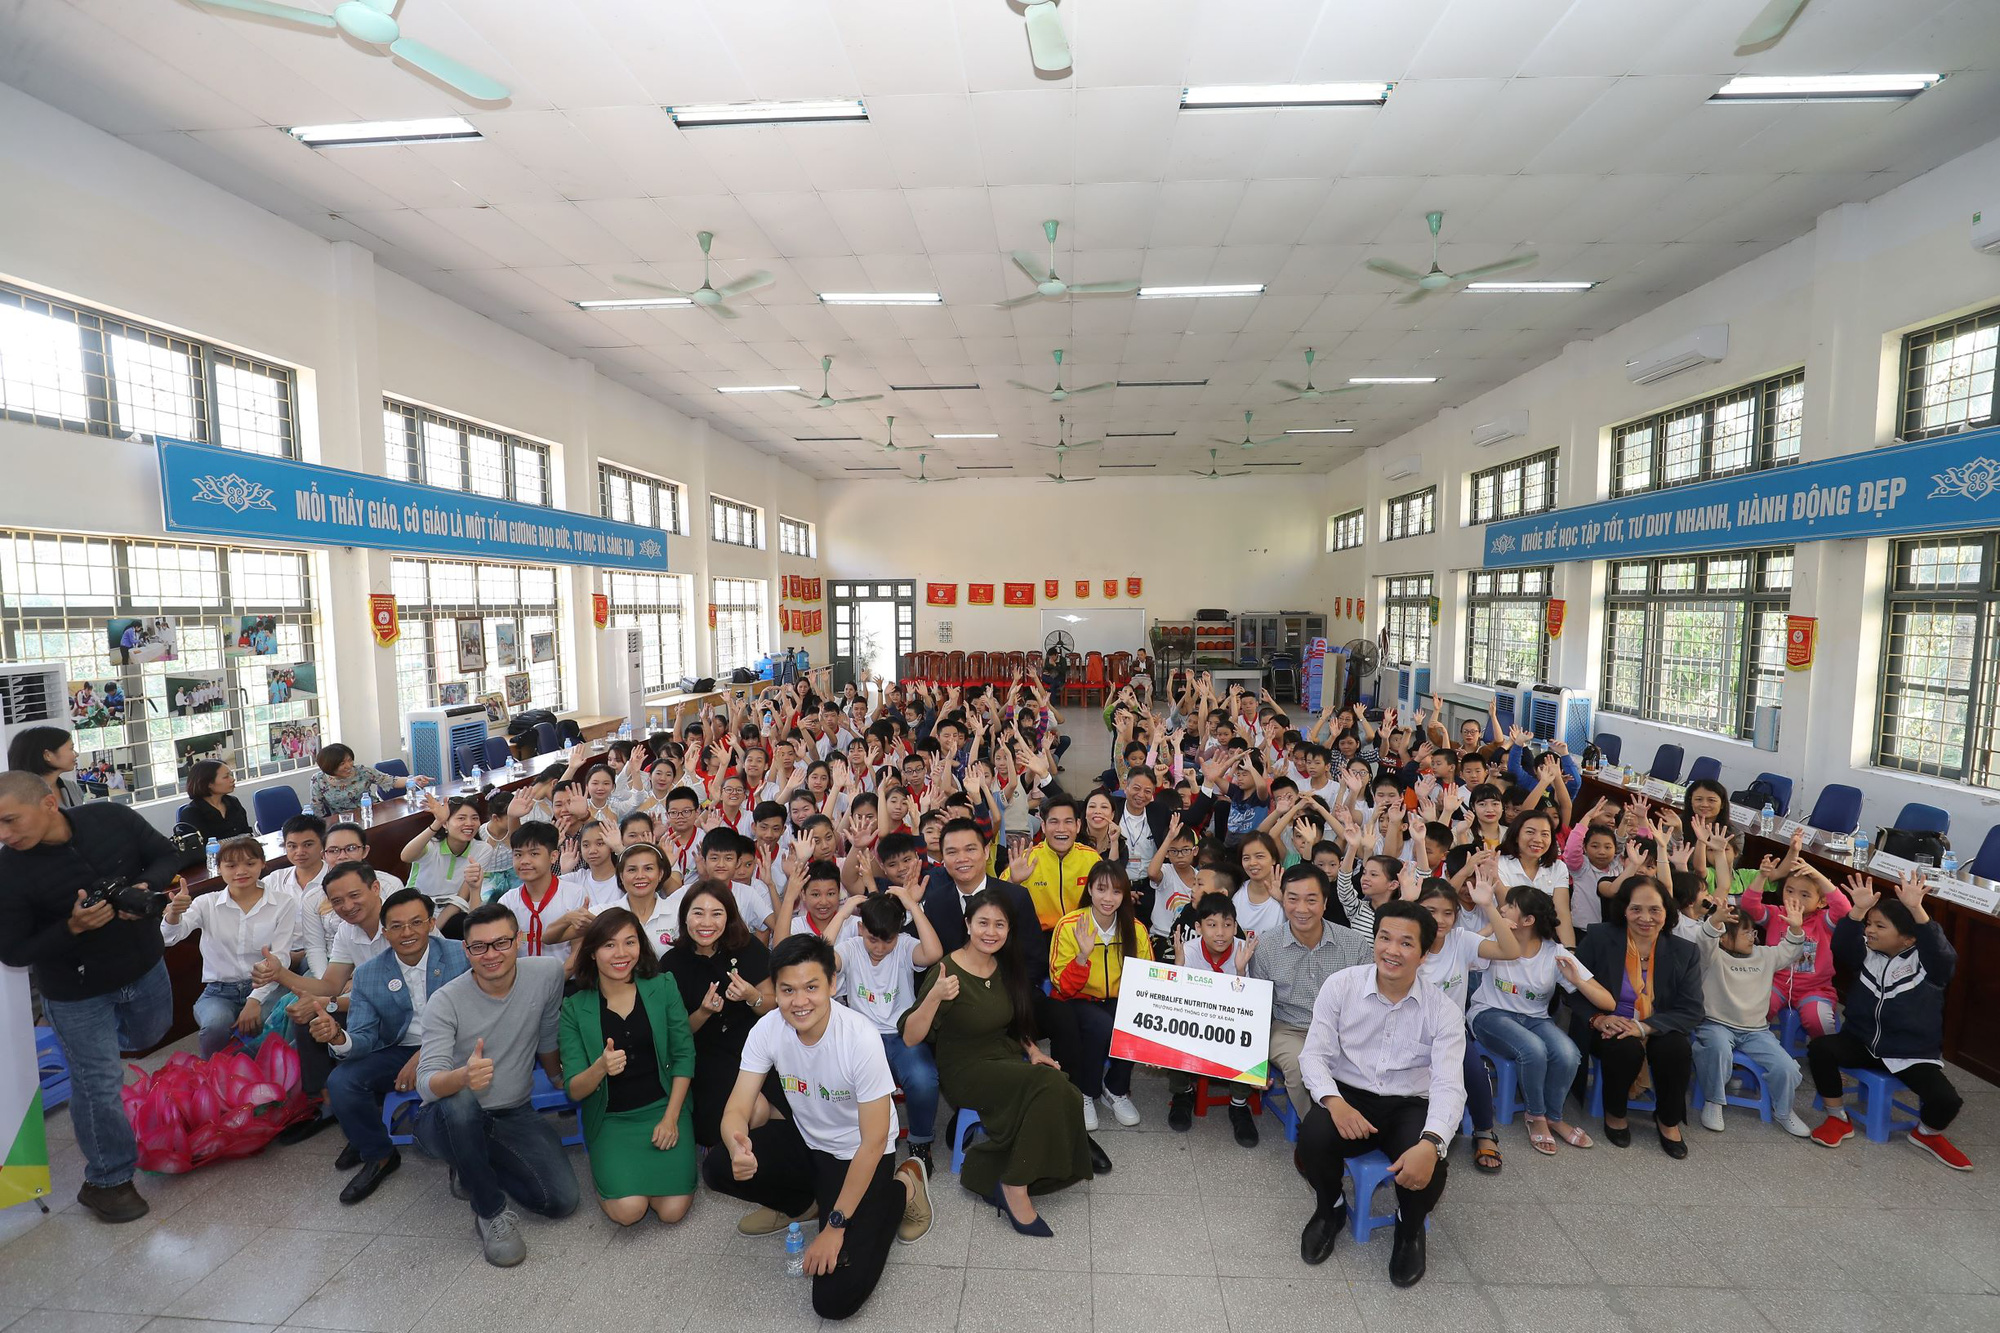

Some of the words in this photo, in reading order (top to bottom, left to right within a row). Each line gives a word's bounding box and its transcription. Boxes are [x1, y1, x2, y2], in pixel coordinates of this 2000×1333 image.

[295, 481, 327, 523] MỖI
[329, 488, 364, 527] THẦY
[367, 497, 401, 534] GIÁO,
[403, 502, 420, 534] CÔ
[422, 505, 448, 537] GIÁO
[450, 508, 464, 538] LÀ
[465, 511, 486, 545] MỘT
[488, 511, 507, 543] TẤM
[509, 520, 538, 546] GƯƠNG
[538, 525, 554, 552] ĐẠO
[556, 524, 573, 553] ĐỨC,
[573, 529, 583, 555] TỰ
[583, 532, 597, 556] HỌC
[597, 531, 606, 554] VÀ
[606, 533, 623, 556] SÁNG
[623, 537, 635, 560] TẠO
[1521, 526, 1543, 552] KHỎE
[1544, 521, 1559, 549] ĐỂ
[1559, 527, 1578, 551] HỌC
[1581, 520, 1600, 549] TẬP
[1604, 512, 1624, 543] TỐT,
[1628, 513, 1645, 540] TƯ
[1646, 511, 1673, 537] DUY
[1675, 502, 1731, 534] NHANH,
[1737, 493, 1788, 527] HÀNH
[1792, 484, 1851, 525] ĐỘNG
[1857, 477, 1907, 518] ĐẸP
[1194, 974, 1214, 985] CASA
[1136, 989, 1149, 999] QUỸ
[1149, 991, 1183, 1005] HERBALIFE
[1184, 998, 1218, 1011] NUTRITION
[1218, 1004, 1236, 1014] TRAO
[1237, 1006, 1254, 1018] TẶNG
[1152, 1003, 1173, 1012] TRƯỜNG
[1184, 1008, 1200, 1016] THÔNG
[1133, 1012, 1236, 1045] 463.000.000
[1240, 1031, 1252, 1048] Đ
